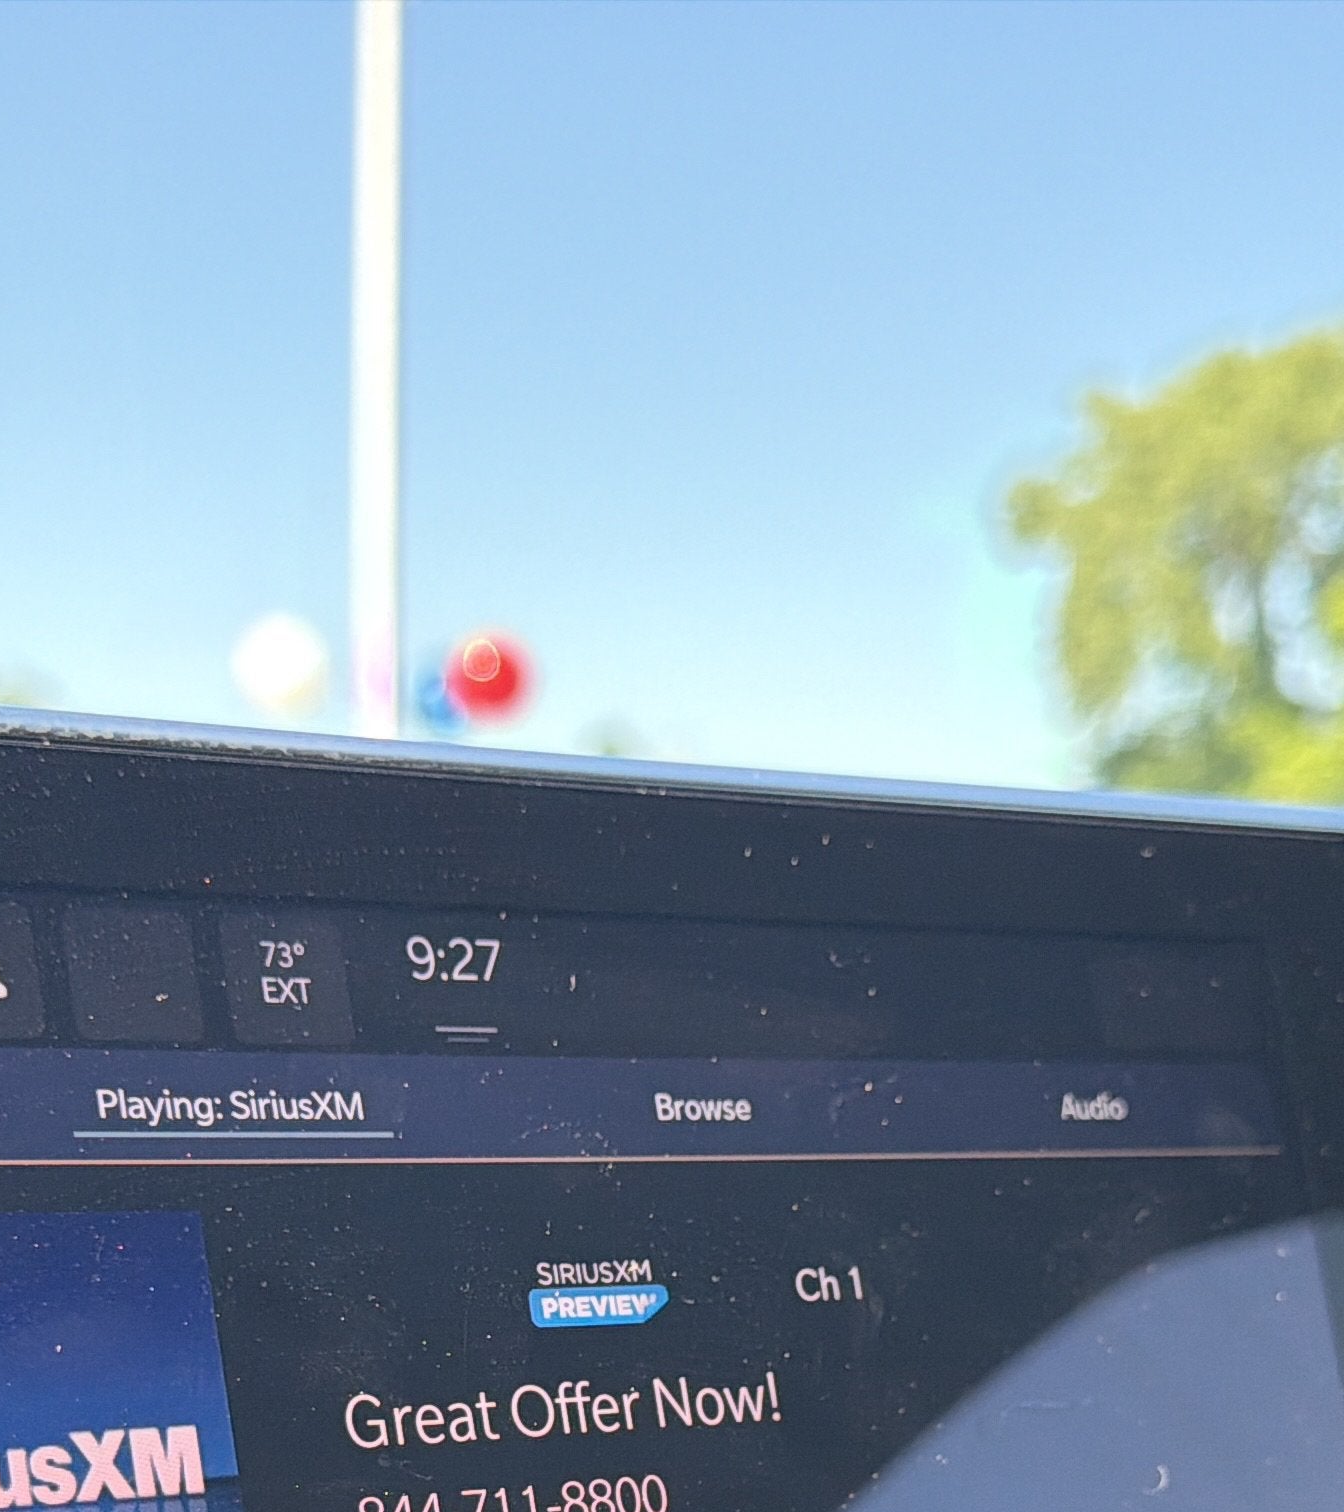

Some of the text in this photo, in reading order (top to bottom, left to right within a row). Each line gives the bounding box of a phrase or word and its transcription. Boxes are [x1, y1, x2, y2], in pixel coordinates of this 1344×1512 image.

[406, 936, 500, 982] 9:27
[261, 977, 311, 1004] EXT
[96, 1089, 364, 1126] Playing: SiriusXM
[655, 1092, 752, 1122] Browse
[1061, 1091, 1129, 1122] Audio
[536, 1260, 652, 1285] SIRIUSXM
[795, 1266, 864, 1302] Ch 1
[541, 1293, 656, 1319] PREVIEW
[344, 1371, 782, 1449] Great Offer Now!
